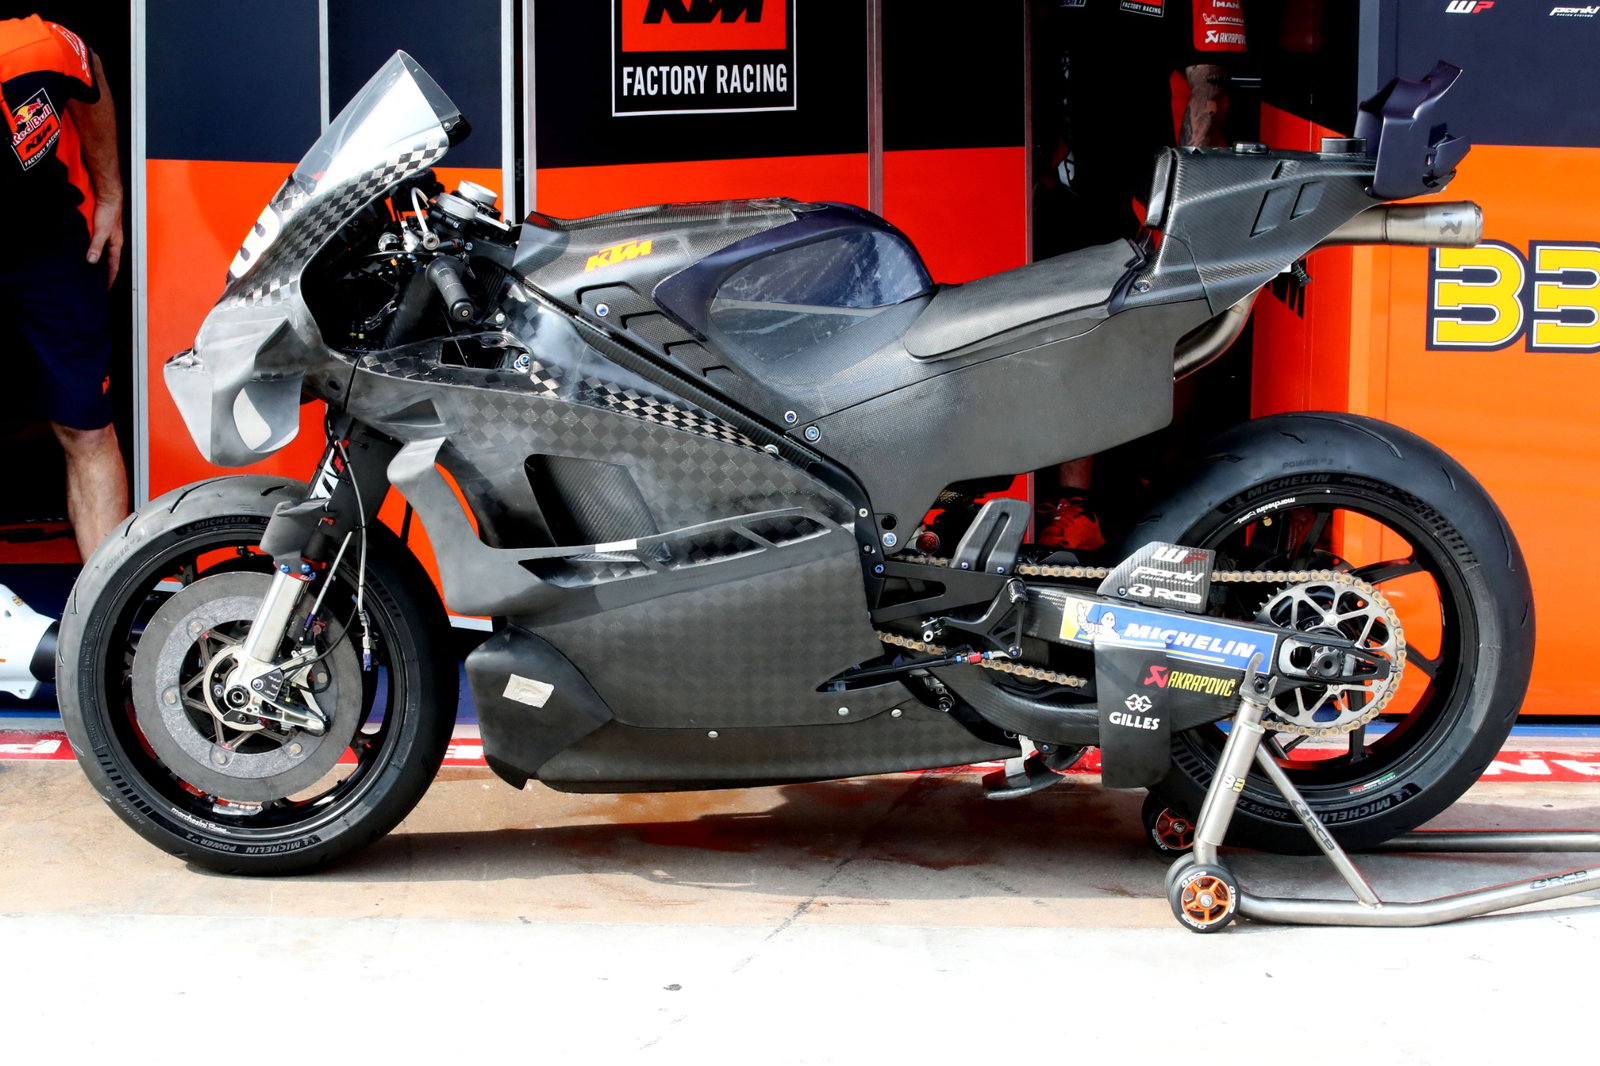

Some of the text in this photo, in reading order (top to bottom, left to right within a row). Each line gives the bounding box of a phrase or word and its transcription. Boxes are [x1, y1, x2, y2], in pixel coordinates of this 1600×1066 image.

[1445, 0, 1495, 14] WP
[622, 63, 788, 96] FACTORY RACING
[25, 149, 46, 167] FACTORY
[583, 239, 653, 273] KTM
[1247, 473, 1331, 499] MICHELIN
[194, 516, 251, 530] MICHELIN
[1152, 546, 1209, 564] WP
[1124, 622, 1257, 658] MICHELIN
[1109, 711, 1161, 730] GILLES
[201, 839, 238, 852] POWER
[245, 841, 301, 854] MICHELIN
